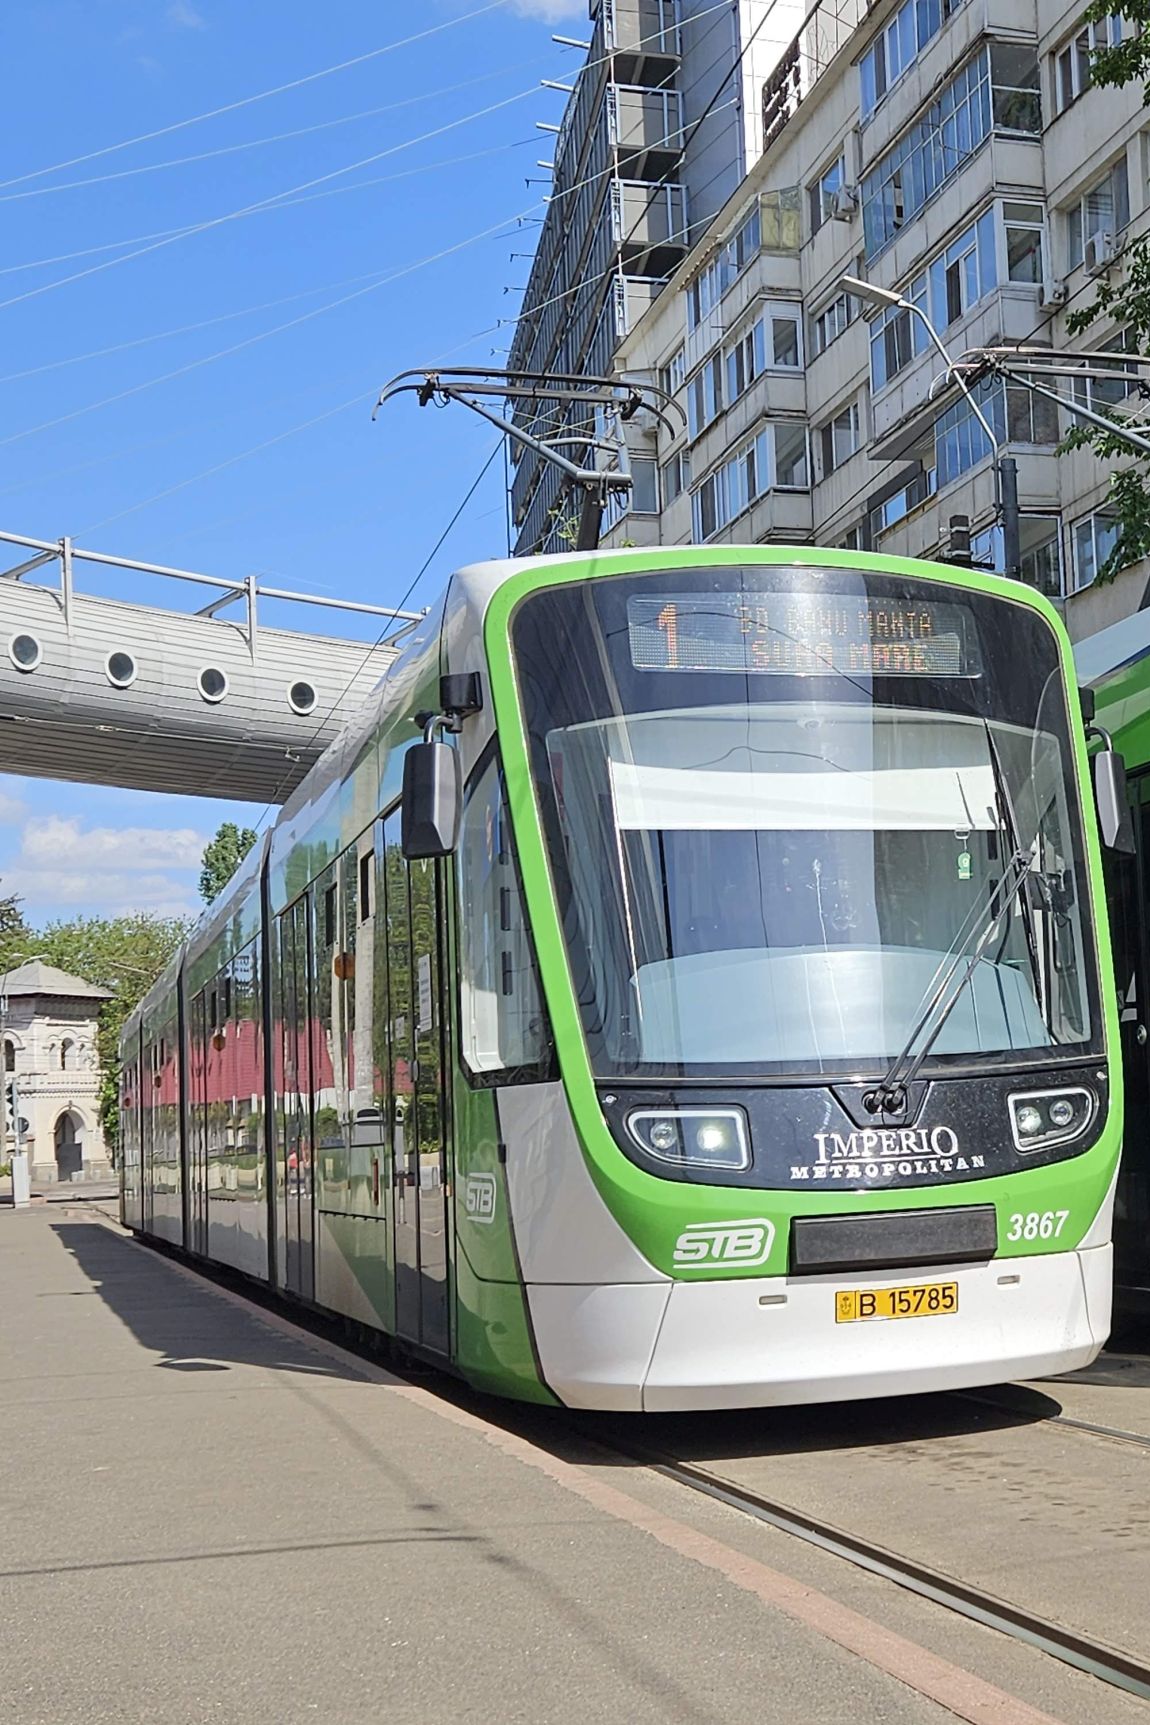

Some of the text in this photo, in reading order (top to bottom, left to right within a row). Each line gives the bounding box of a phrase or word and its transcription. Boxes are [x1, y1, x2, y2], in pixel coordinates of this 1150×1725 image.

[658, 602, 678, 669] 1
[857, 608, 933, 639] MANTA
[849, 642, 928, 671] MARE
[813, 1126, 960, 1164] IMPERIO
[790, 1155, 986, 1181] METROPOLITAN
[466, 1182, 493, 1213] STB
[1006, 1209, 1071, 1242] 3867
[673, 1227, 765, 1261] STB
[858, 1285, 956, 1317] B 15785
